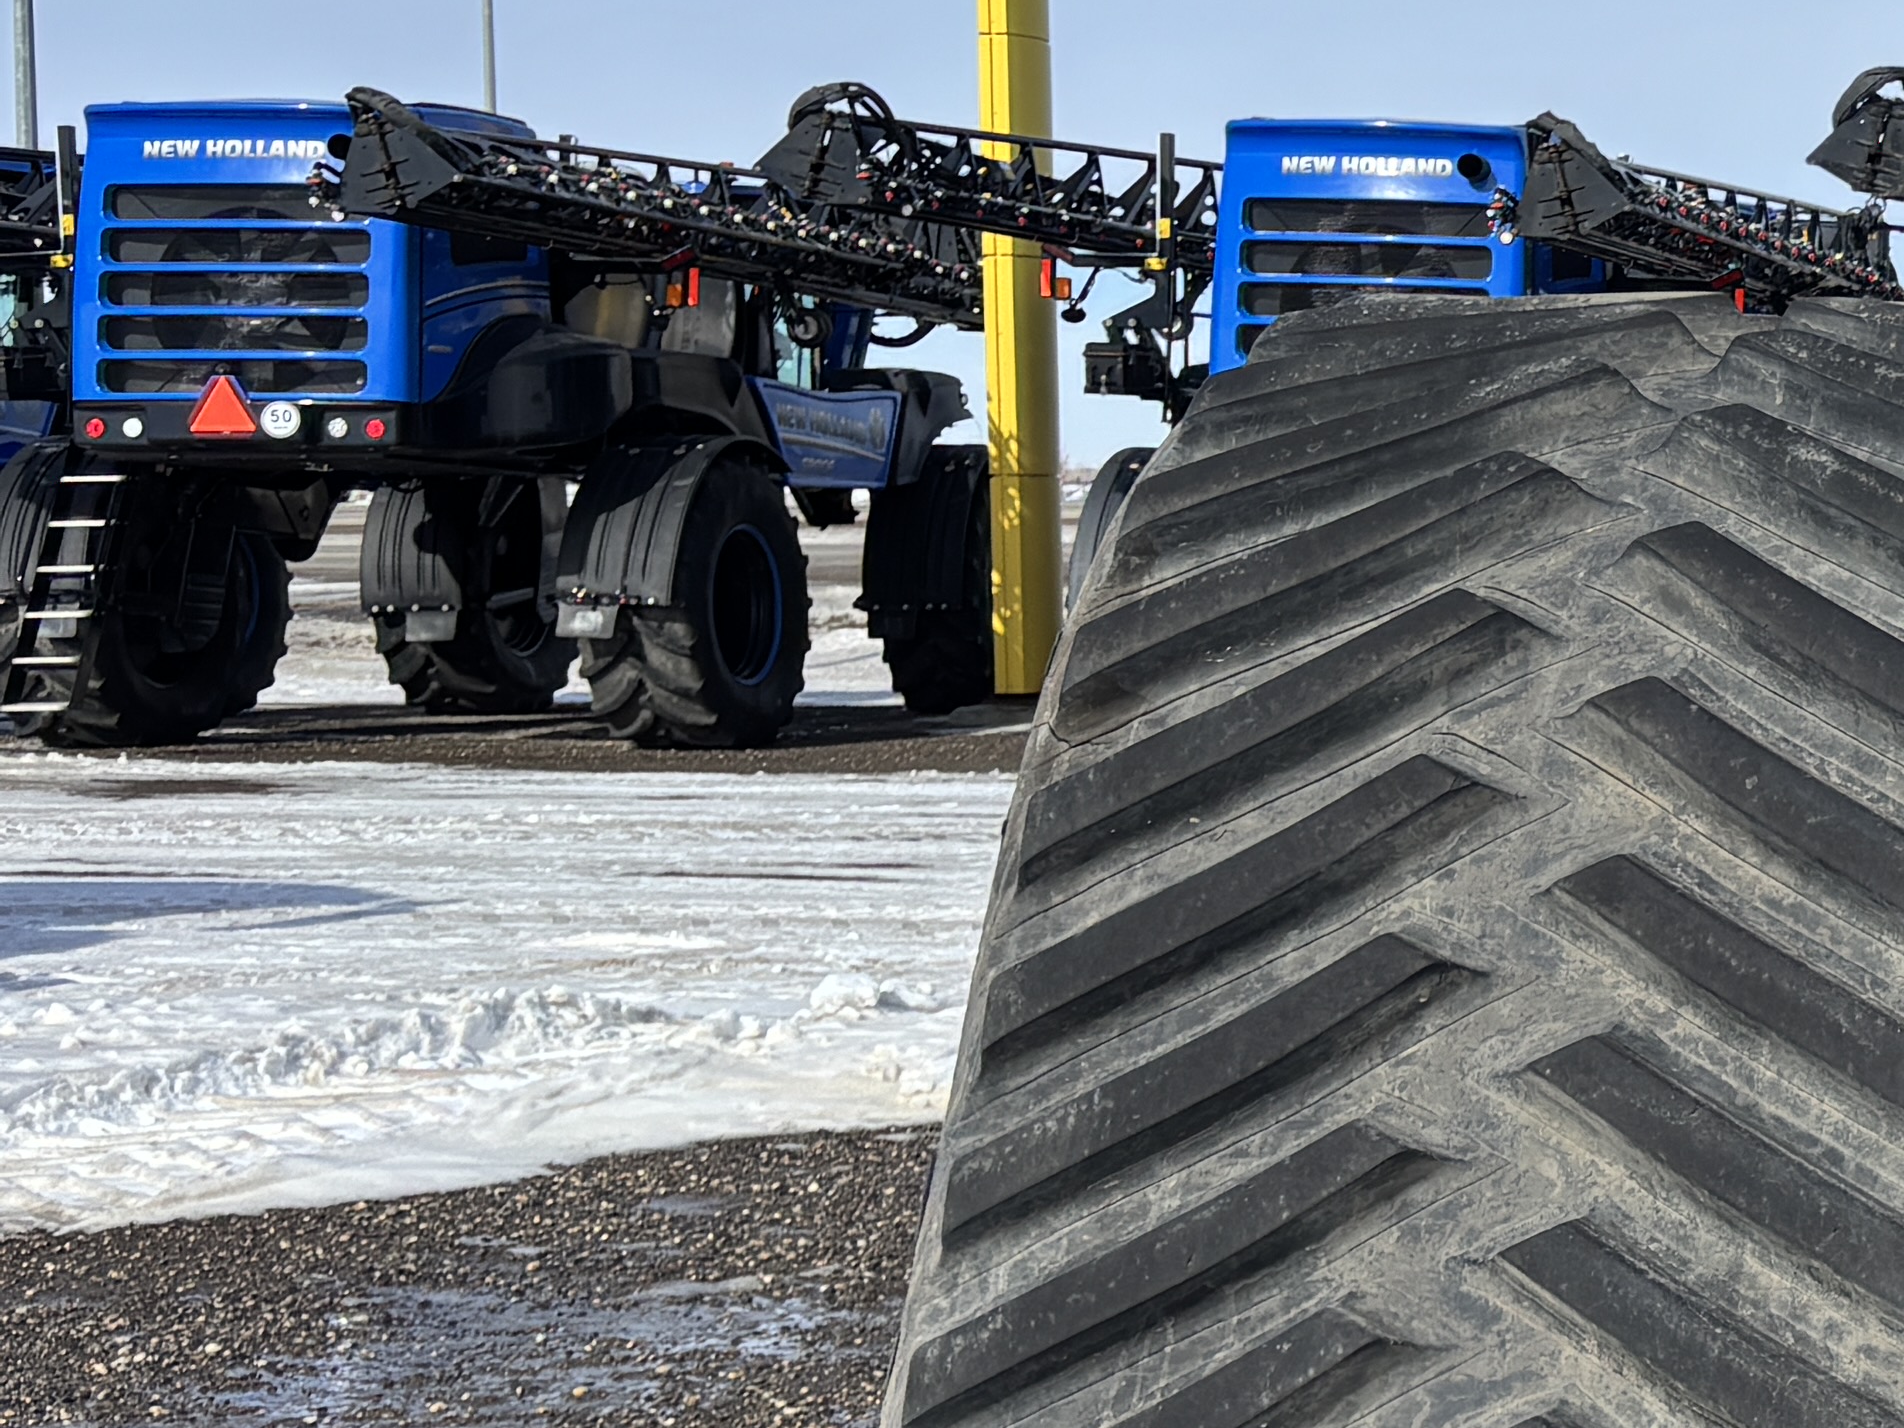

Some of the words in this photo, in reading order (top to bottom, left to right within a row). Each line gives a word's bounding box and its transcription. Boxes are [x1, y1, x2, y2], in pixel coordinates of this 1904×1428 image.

[143, 139, 200, 158] NEW
[206, 139, 326, 159] HOLLAND
[1282, 155, 1336, 176] NEW
[1341, 155, 1453, 178] HOLLAND
[270, 409, 292, 423] 50
